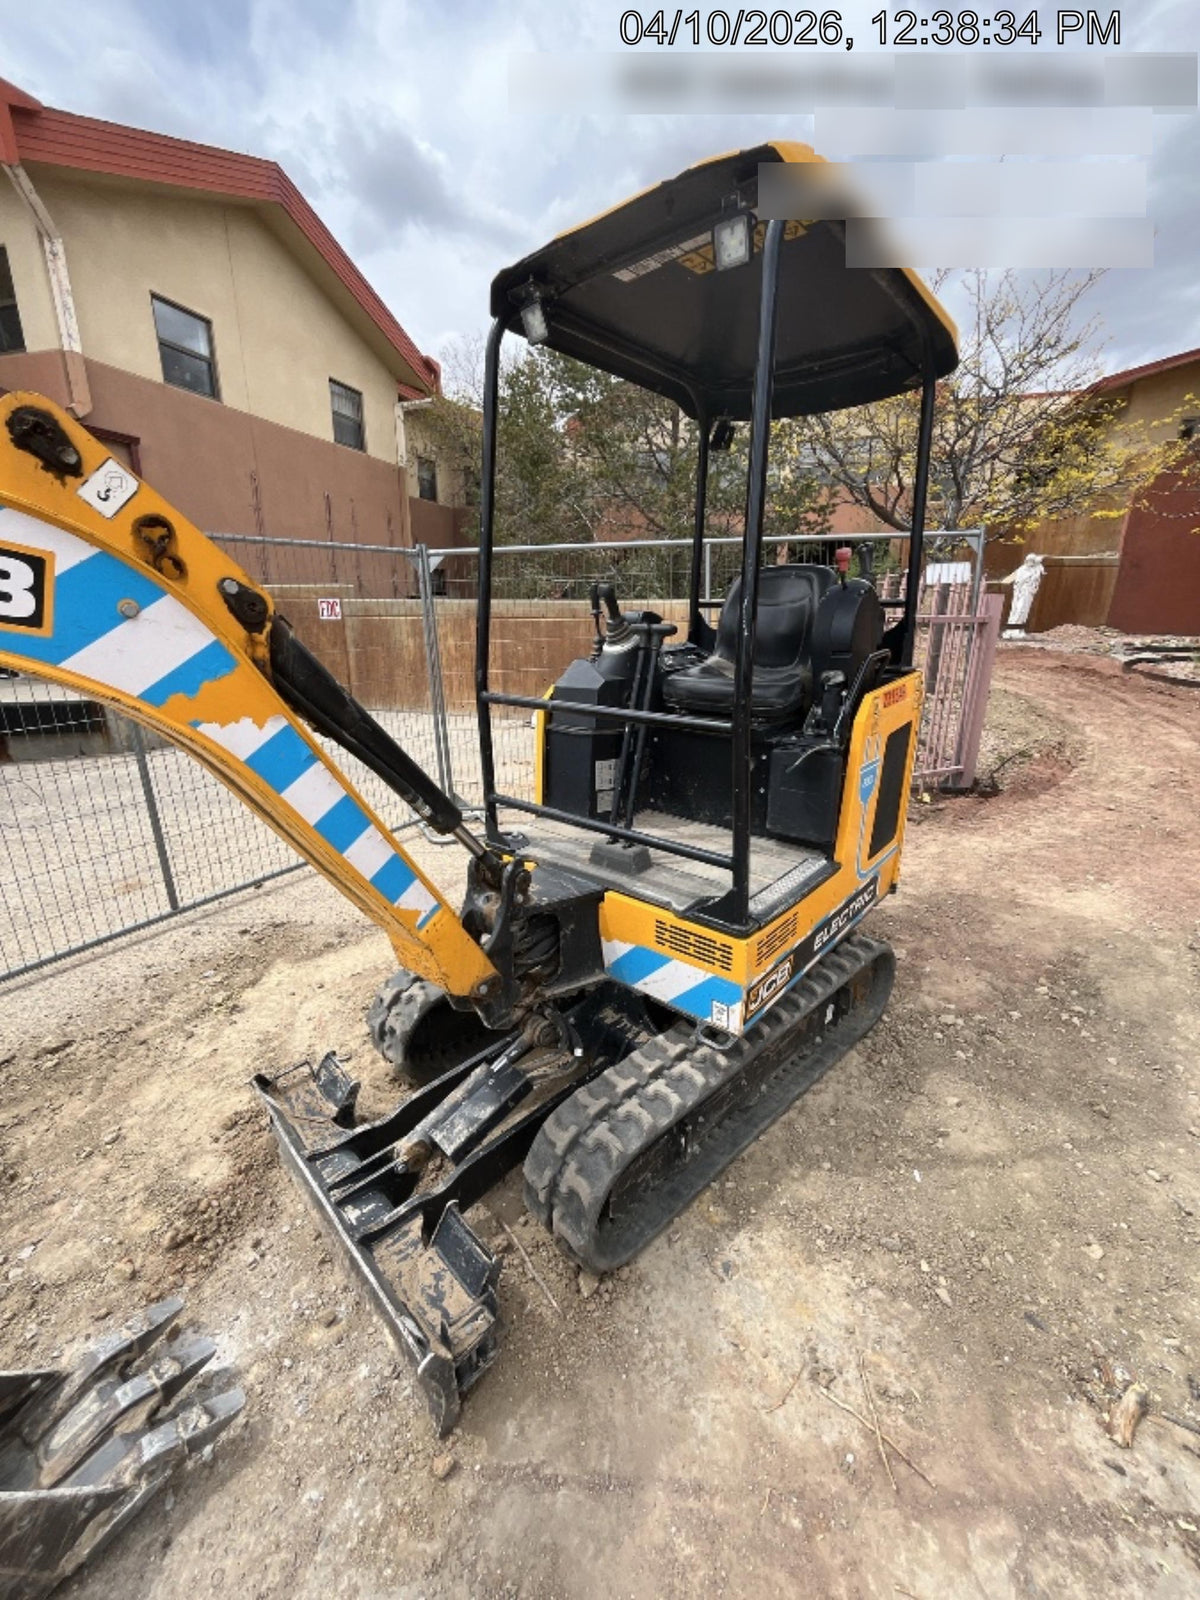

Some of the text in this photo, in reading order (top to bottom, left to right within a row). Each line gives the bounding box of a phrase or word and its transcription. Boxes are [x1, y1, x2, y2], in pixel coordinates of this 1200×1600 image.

[320, 600, 341, 617] FDC
[813, 883, 877, 952] ELECTRIC
[749, 960, 792, 1011] JCB
